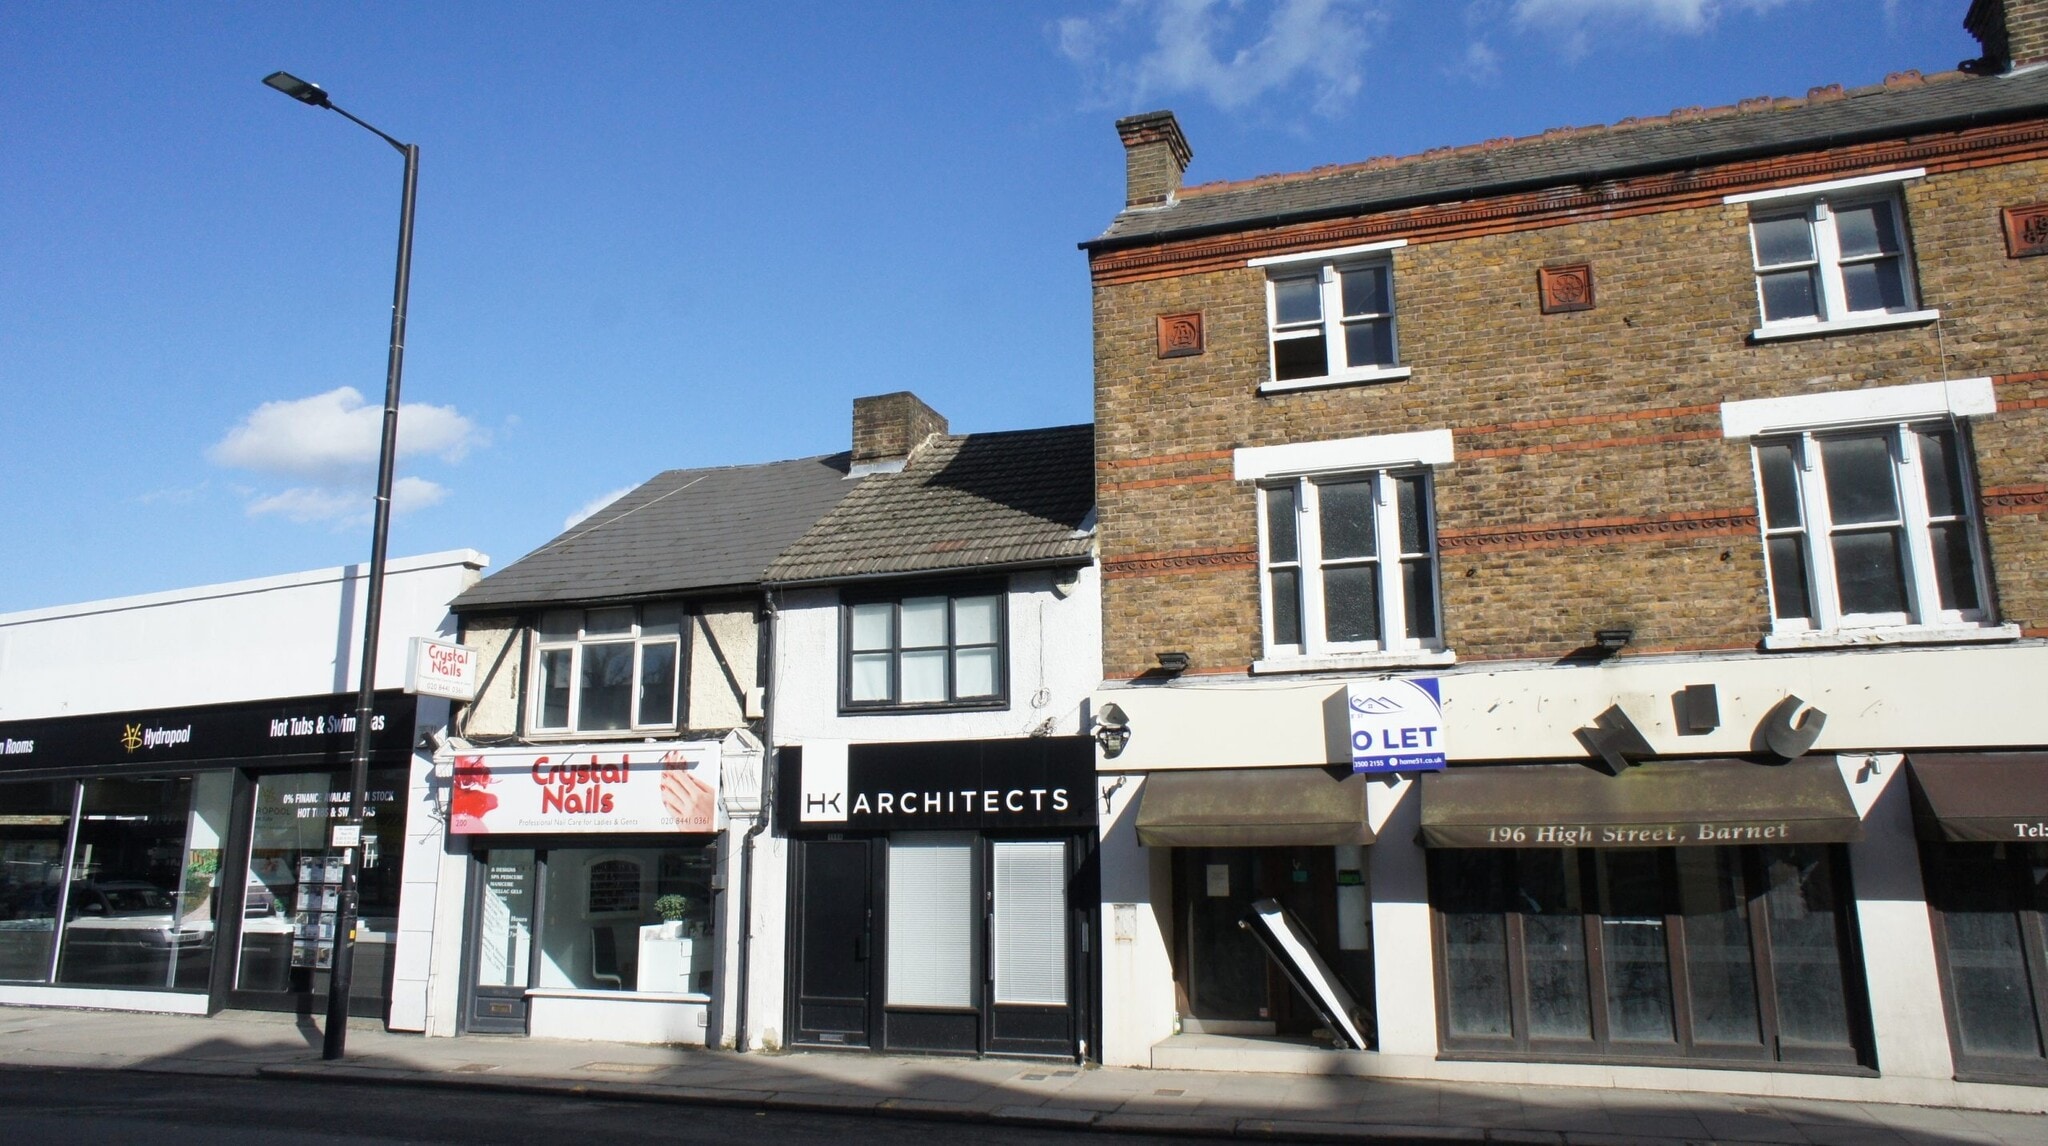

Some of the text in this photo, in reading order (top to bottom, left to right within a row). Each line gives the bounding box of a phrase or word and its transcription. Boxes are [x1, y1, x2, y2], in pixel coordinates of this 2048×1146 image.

[428, 644, 468, 665] Crystal
[432, 660, 462, 677] Nails
[270, 713, 385, 737] Hot Tubs & Swim as
[5, 738, 34, 754] Rooms
[143, 725, 191, 749] Hydropool
[1352, 726, 1438, 751] O LET
[1399, 756, 1443, 767] home51.co.uk
[532, 754, 629, 793] Crystal
[283, 794, 294, 804] 0%
[324, 792, 351, 803] AVAILAB
[371, 790, 394, 802] STOCK
[541, 784, 615, 814] Nails
[806, 789, 1069, 814] HK ARCHITECTS
[297, 806, 376, 818] HOT TUBS & SW PAS
[518, 818, 553, 827] Professional
[554, 818, 567, 826] Nail
[567, 818, 583, 826] Care
[583, 818, 593, 826] for
[593, 817, 613, 826] Ladies
[613, 817, 620, 826] &
[620, 817, 638, 826] Gents
[660, 816, 674, 825] 020
[675, 816, 691, 825] 8441
[693, 816, 710, 825] 0361
[1487, 822, 1789, 847] 196 High Street, Barnet
[2013, 822, 2048, 838] Tel:
